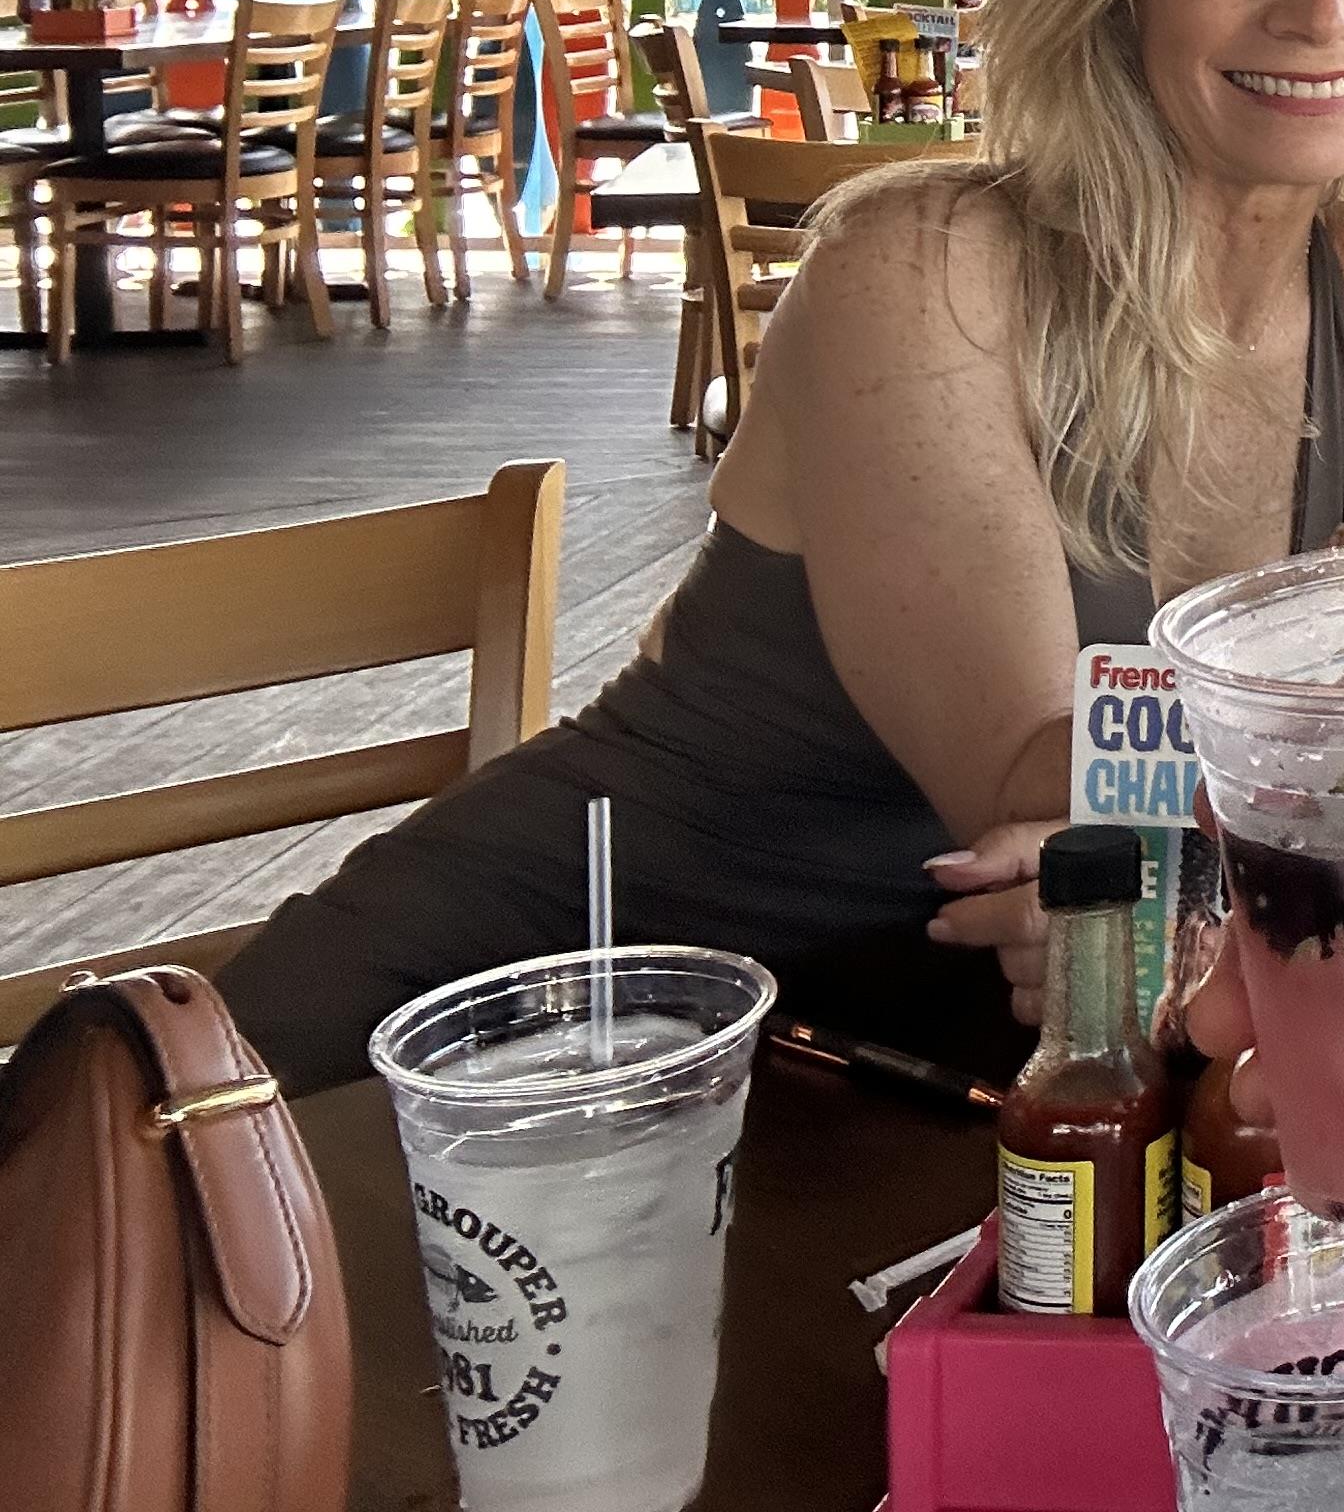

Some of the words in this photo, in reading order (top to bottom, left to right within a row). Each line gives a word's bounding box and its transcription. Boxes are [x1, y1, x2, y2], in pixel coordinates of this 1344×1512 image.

[909, 11, 956, 25] OCKTAIL
[1090, 654, 1176, 690] Frenc
[1088, 694, 1194, 754] COC
[1085, 758, 1199, 816] CHA
[414, 1181, 568, 1331] GROUPER
[456, 1367, 562, 1450] FRESH
